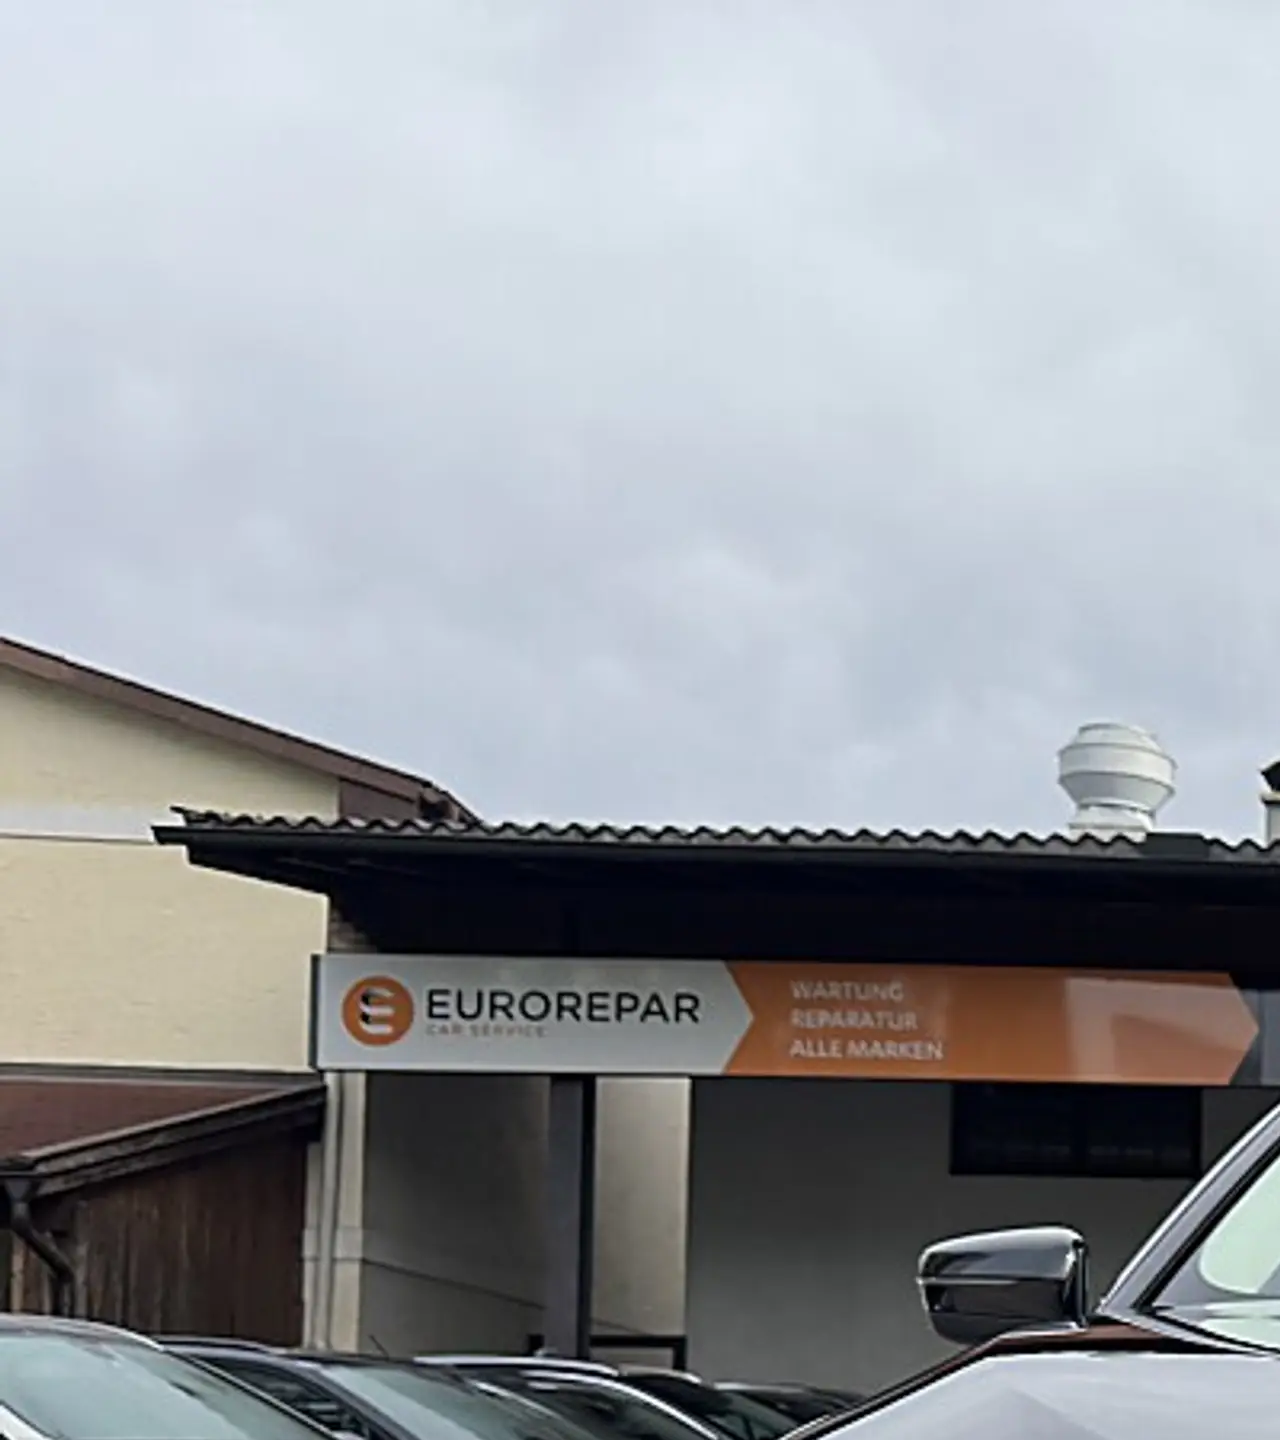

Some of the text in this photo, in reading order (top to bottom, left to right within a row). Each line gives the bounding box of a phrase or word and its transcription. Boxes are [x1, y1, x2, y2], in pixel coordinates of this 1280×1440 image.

[790, 980, 905, 1003] WARTUNG
[426, 988, 701, 1024] EUROREPAR
[426, 1024, 549, 1038] CAR SERVICE
[790, 1008, 919, 1032] REPARATUR
[790, 1038, 945, 1061] ALLE MARKEN
